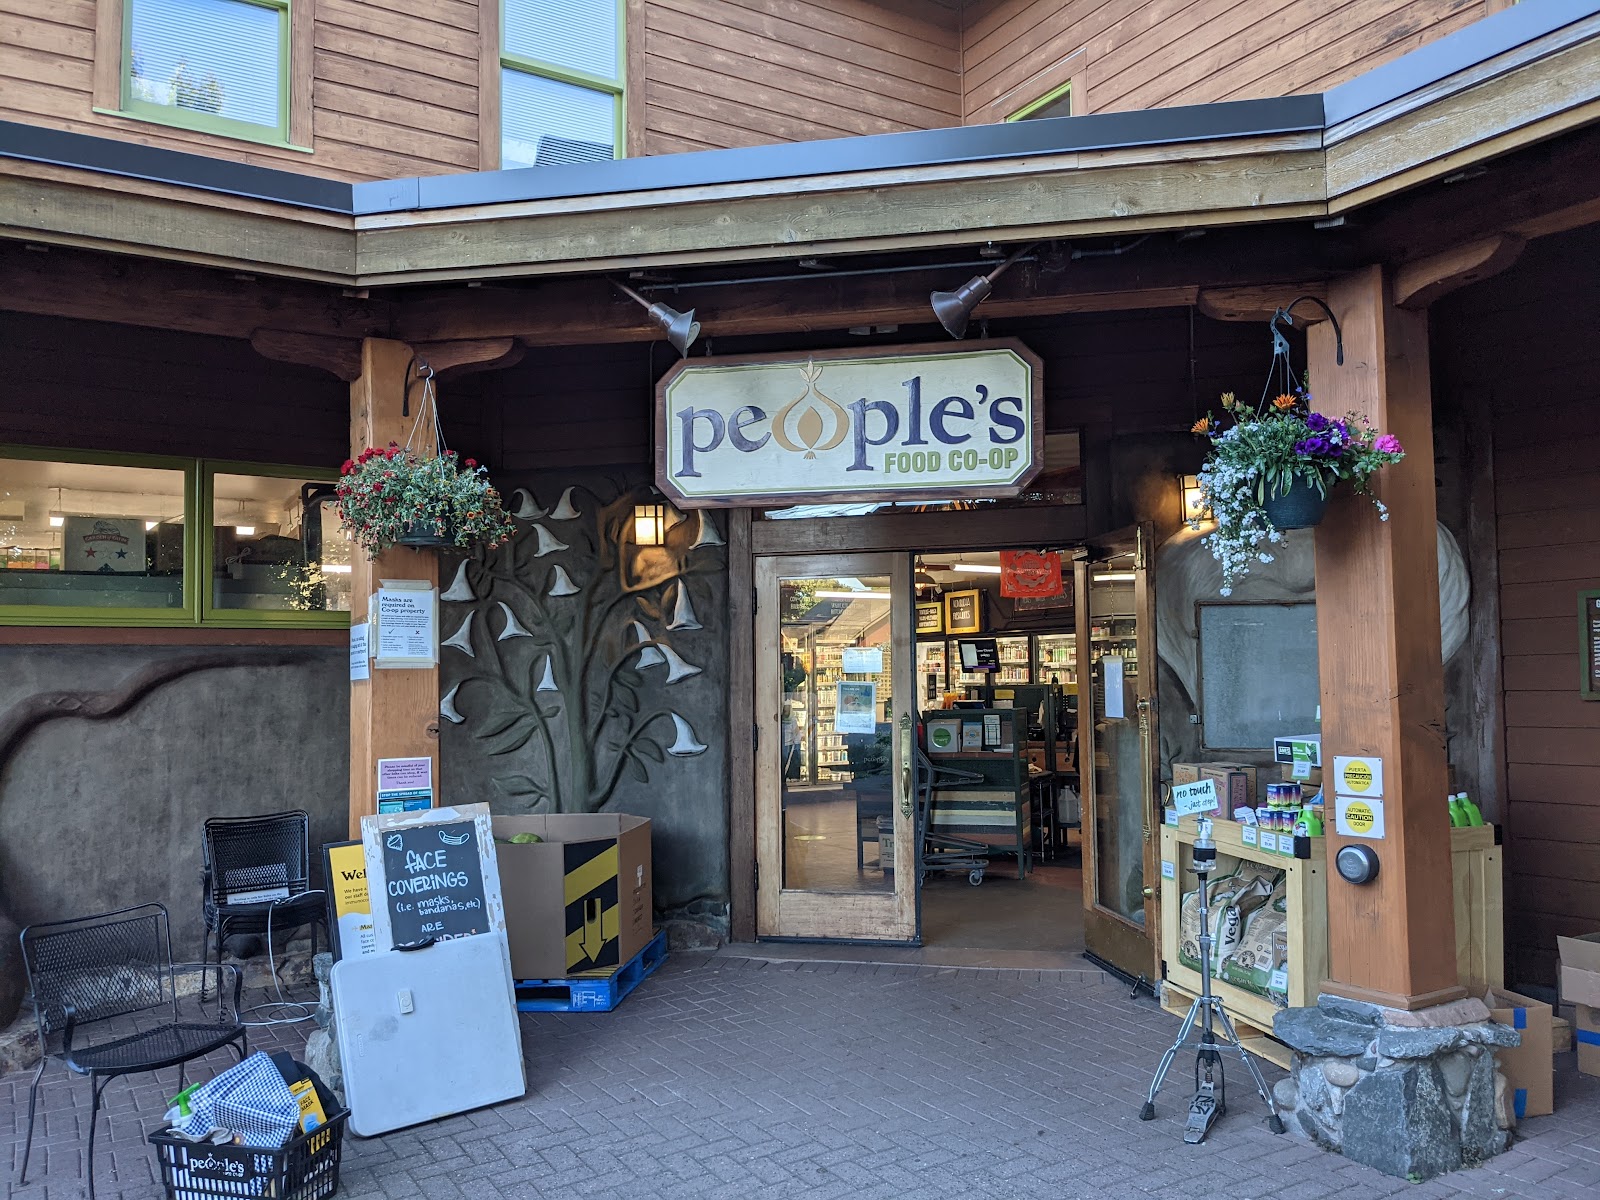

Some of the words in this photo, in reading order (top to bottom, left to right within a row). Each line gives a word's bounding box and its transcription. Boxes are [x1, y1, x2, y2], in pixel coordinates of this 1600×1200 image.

[675, 357, 1025, 477] people's
[884, 451, 941, 474] FOOD
[948, 447, 1019, 472] CO-OP
[381, 602, 406, 610] required
[1175, 789, 1188, 799] no
[1189, 782, 1212, 797] touch
[1346, 813, 1373, 821] CAUTION
[421, 921, 445, 933] ARE
